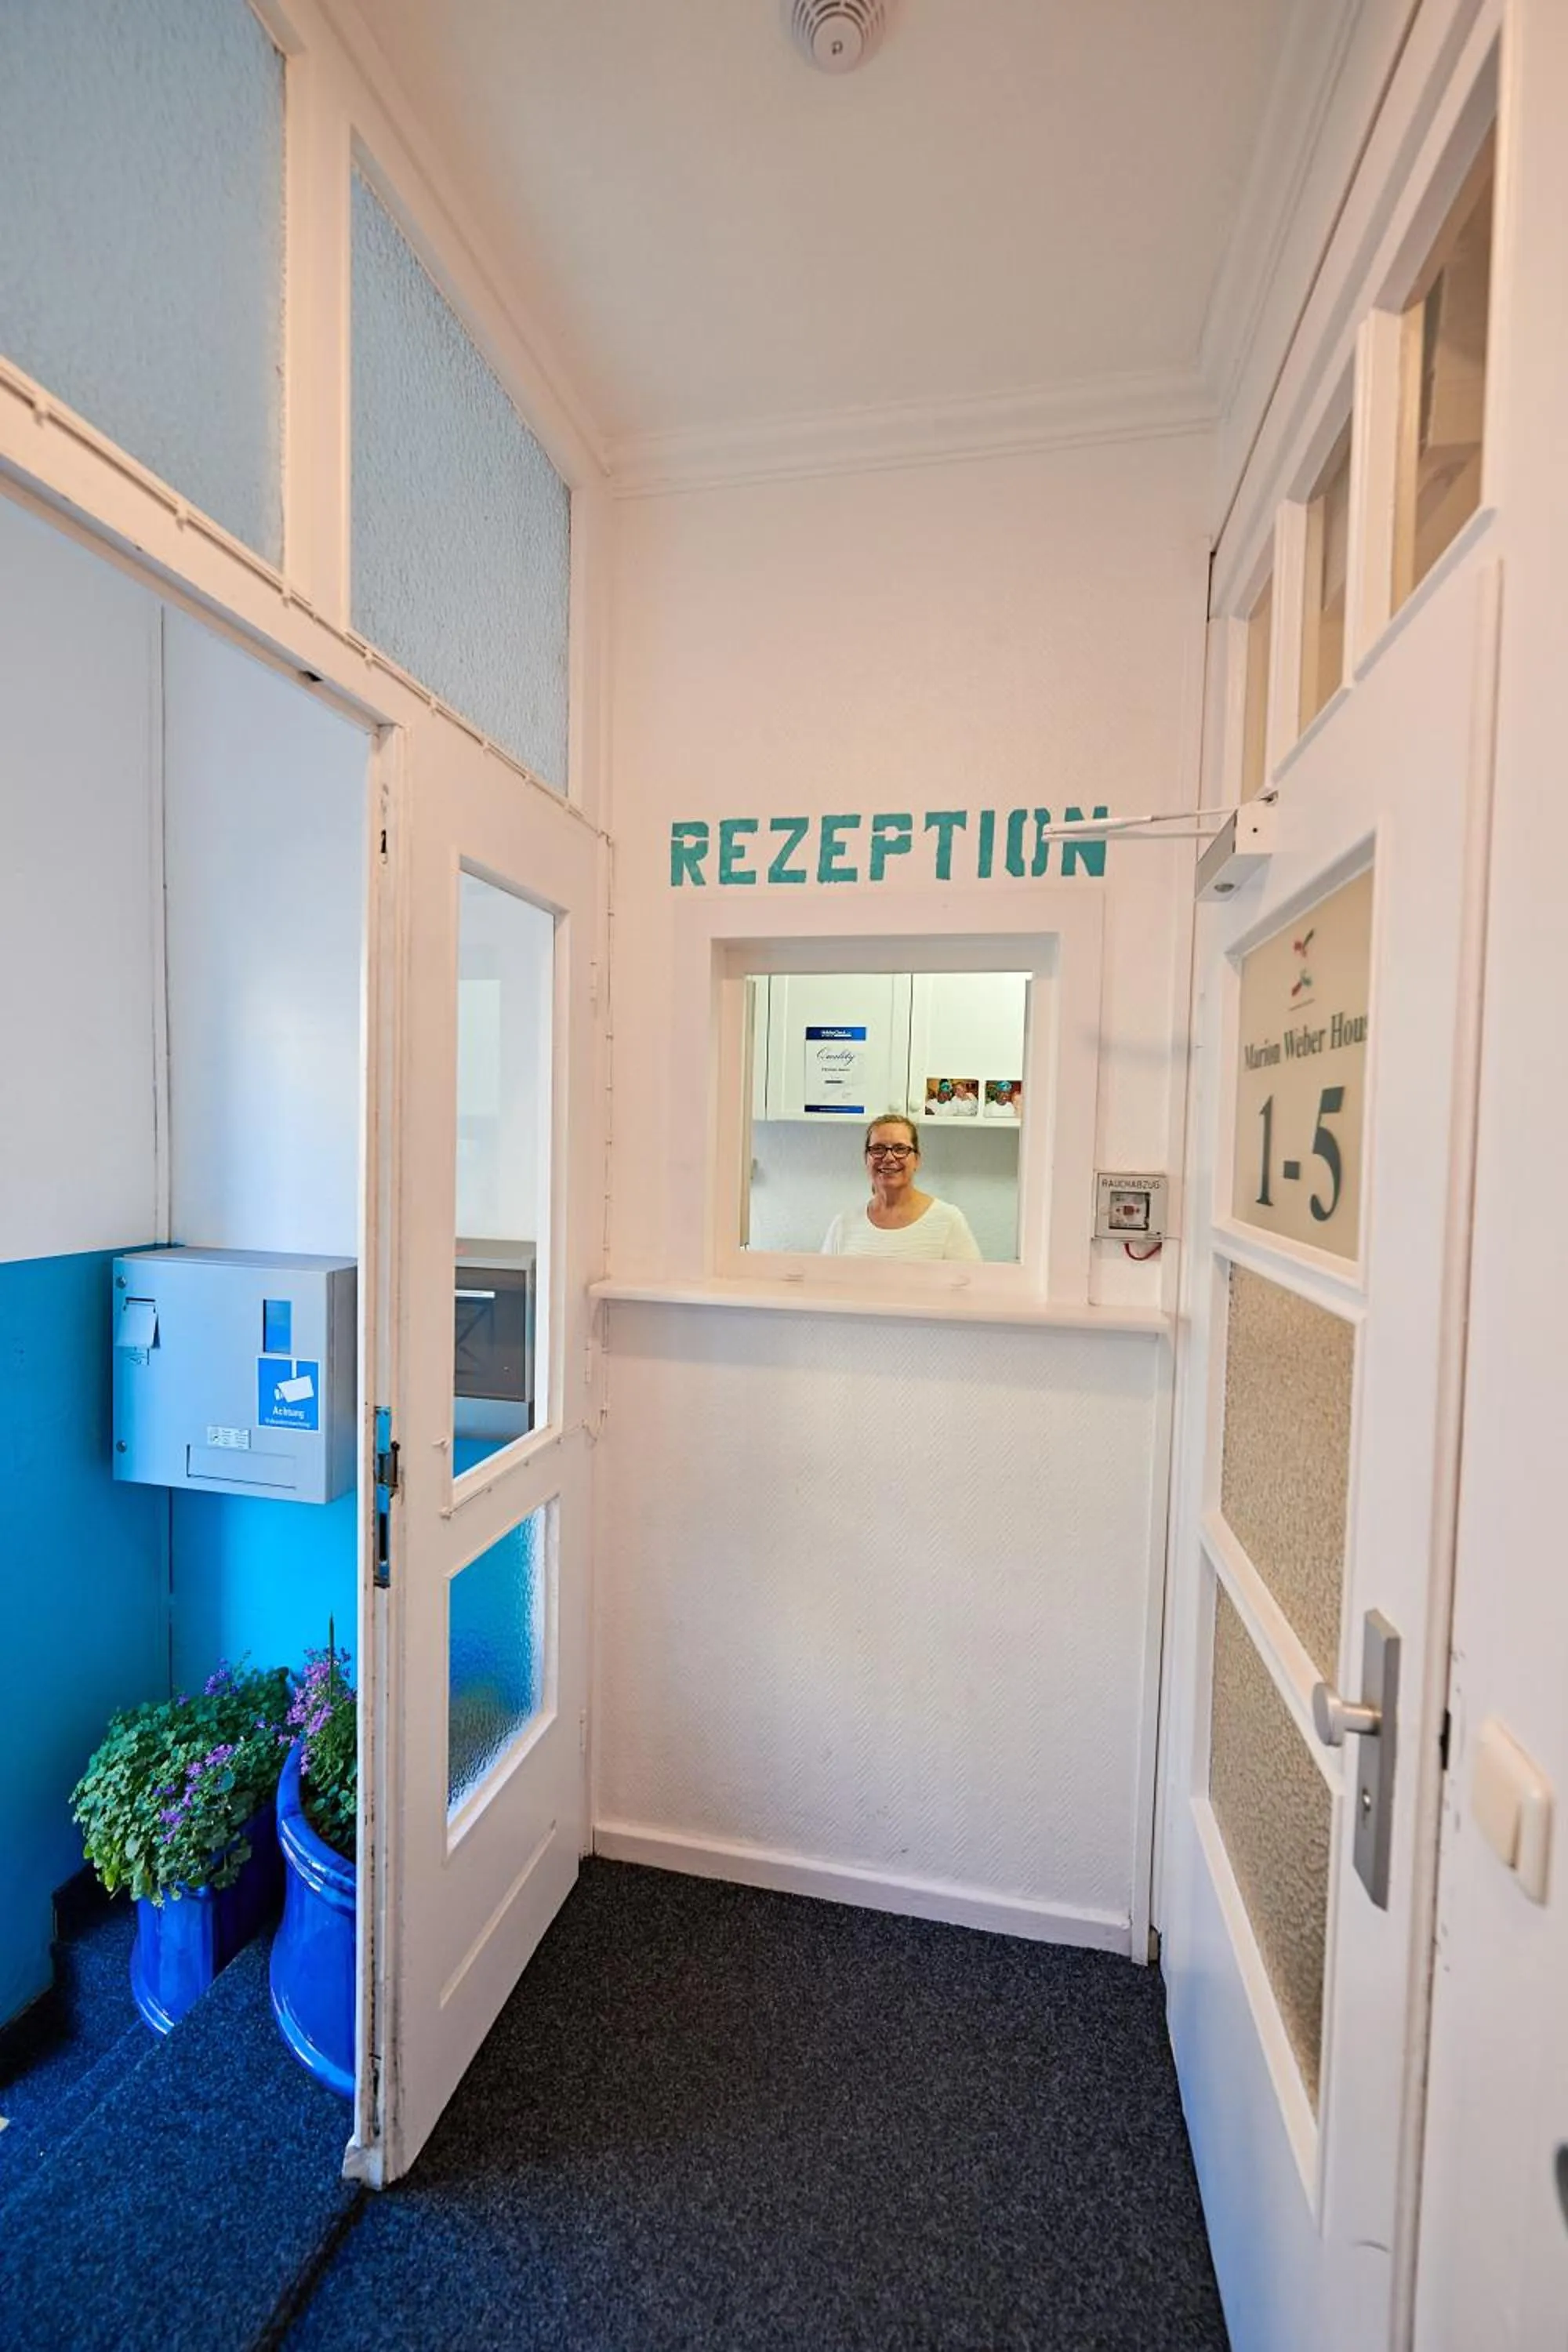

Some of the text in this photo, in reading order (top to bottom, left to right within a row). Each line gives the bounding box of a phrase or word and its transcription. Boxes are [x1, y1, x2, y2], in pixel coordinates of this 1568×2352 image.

[670, 806, 1108, 887] REZEPTION
[1284, 1024, 1327, 1060] Weber
[1256, 1086, 1345, 1222] 1-5
[1102, 1178, 1161, 1189] RAUCHABZUG
[272, 1405, 306, 1420] Achtung
